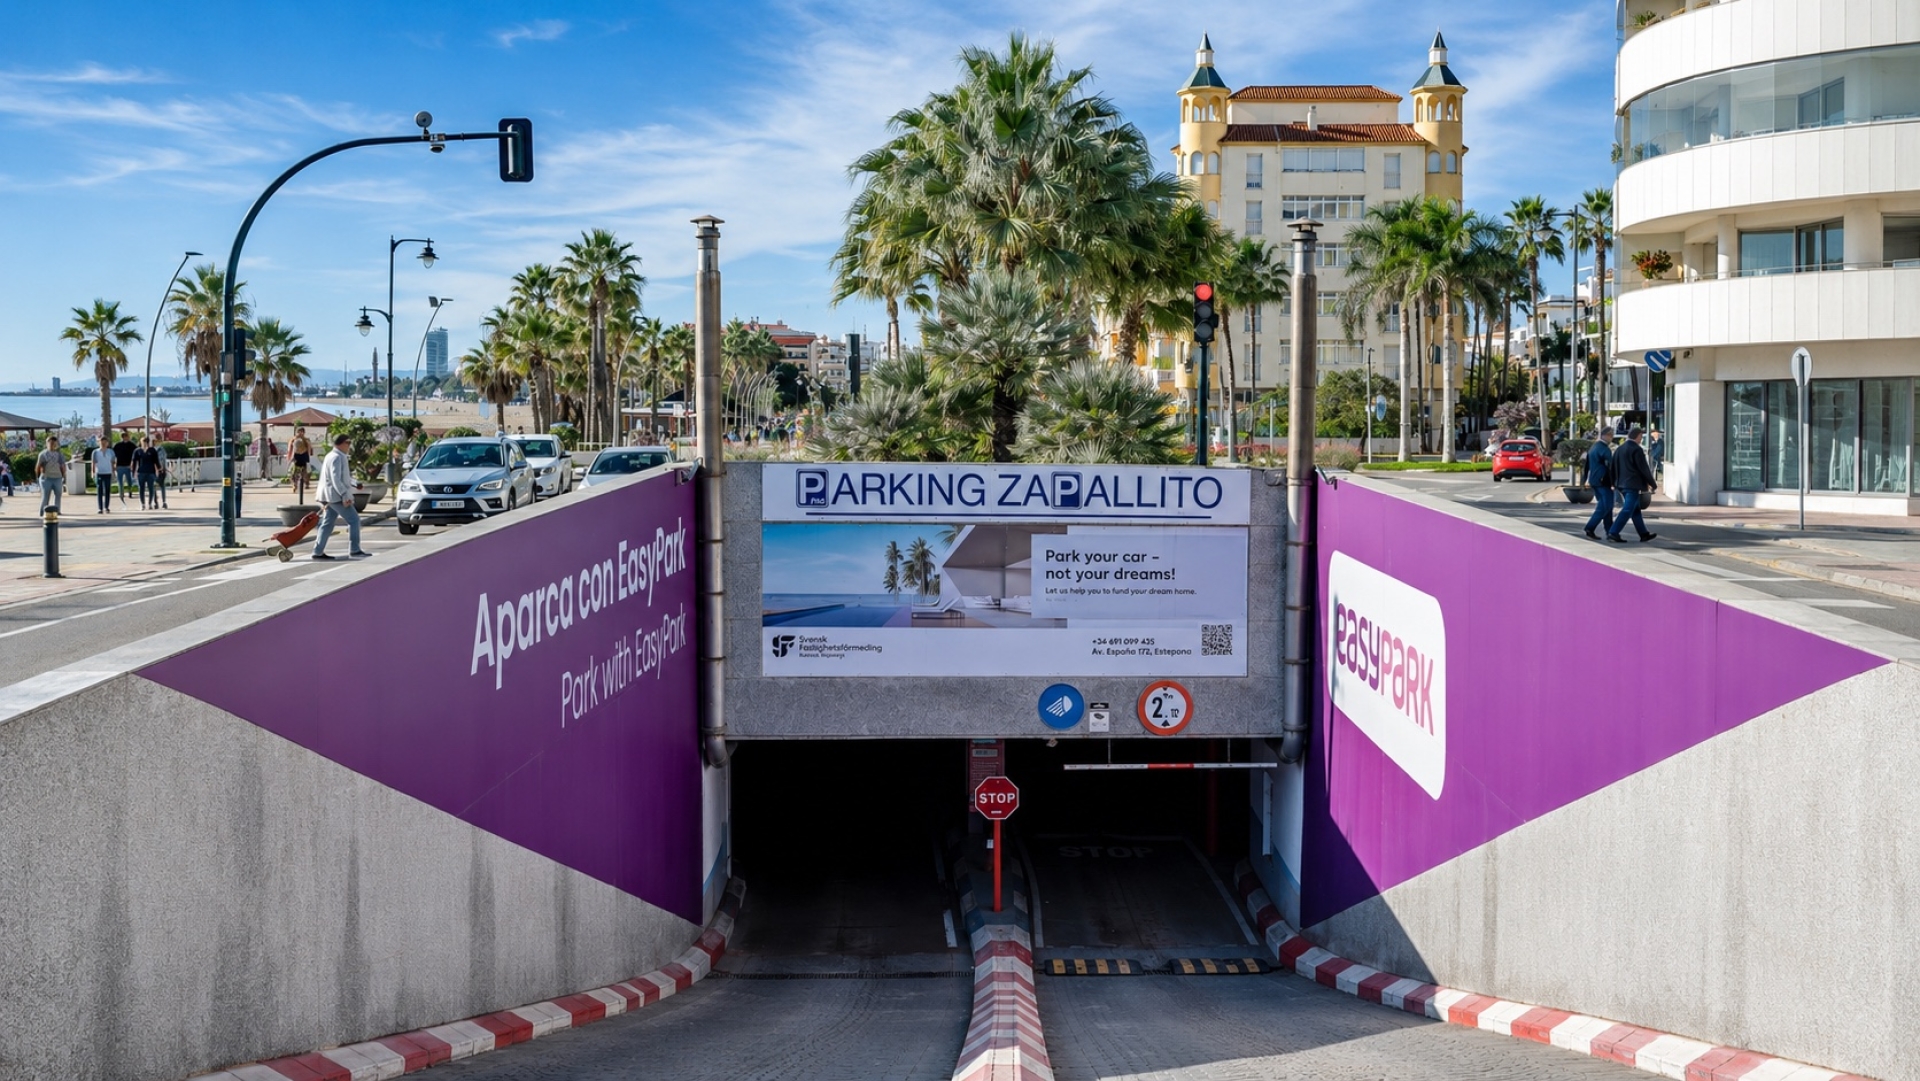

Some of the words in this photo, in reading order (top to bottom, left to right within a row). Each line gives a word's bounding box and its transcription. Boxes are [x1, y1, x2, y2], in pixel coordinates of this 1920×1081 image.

[797, 469, 986, 507] PARKING
[997, 472, 1223, 509] ZAPALLITO
[1045, 550, 1080, 563] Park
[1084, 553, 1118, 565] your
[1122, 553, 1147, 563] car
[1045, 568, 1071, 580] not
[1076, 570, 1110, 583] your
[1114, 567, 1176, 580] dreams!
[1045, 587, 1057, 595] Let
[1070, 587, 1085, 596] help
[1087, 588, 1101, 597] you
[1112, 587, 1129, 596] fund
[1130, 588, 1147, 597] your
[1148, 587, 1173, 596] dream
[1174, 588, 1197, 596] home.
[471, 574, 573, 690] Aparca
[578, 558, 613, 619] con
[618, 517, 686, 607] EasyPark
[562, 655, 598, 728] Park
[602, 636, 632, 700] with
[636, 602, 686, 680] EasyPark
[979, 793, 1016, 804] STOP
[1058, 845, 1154, 858] STOP
